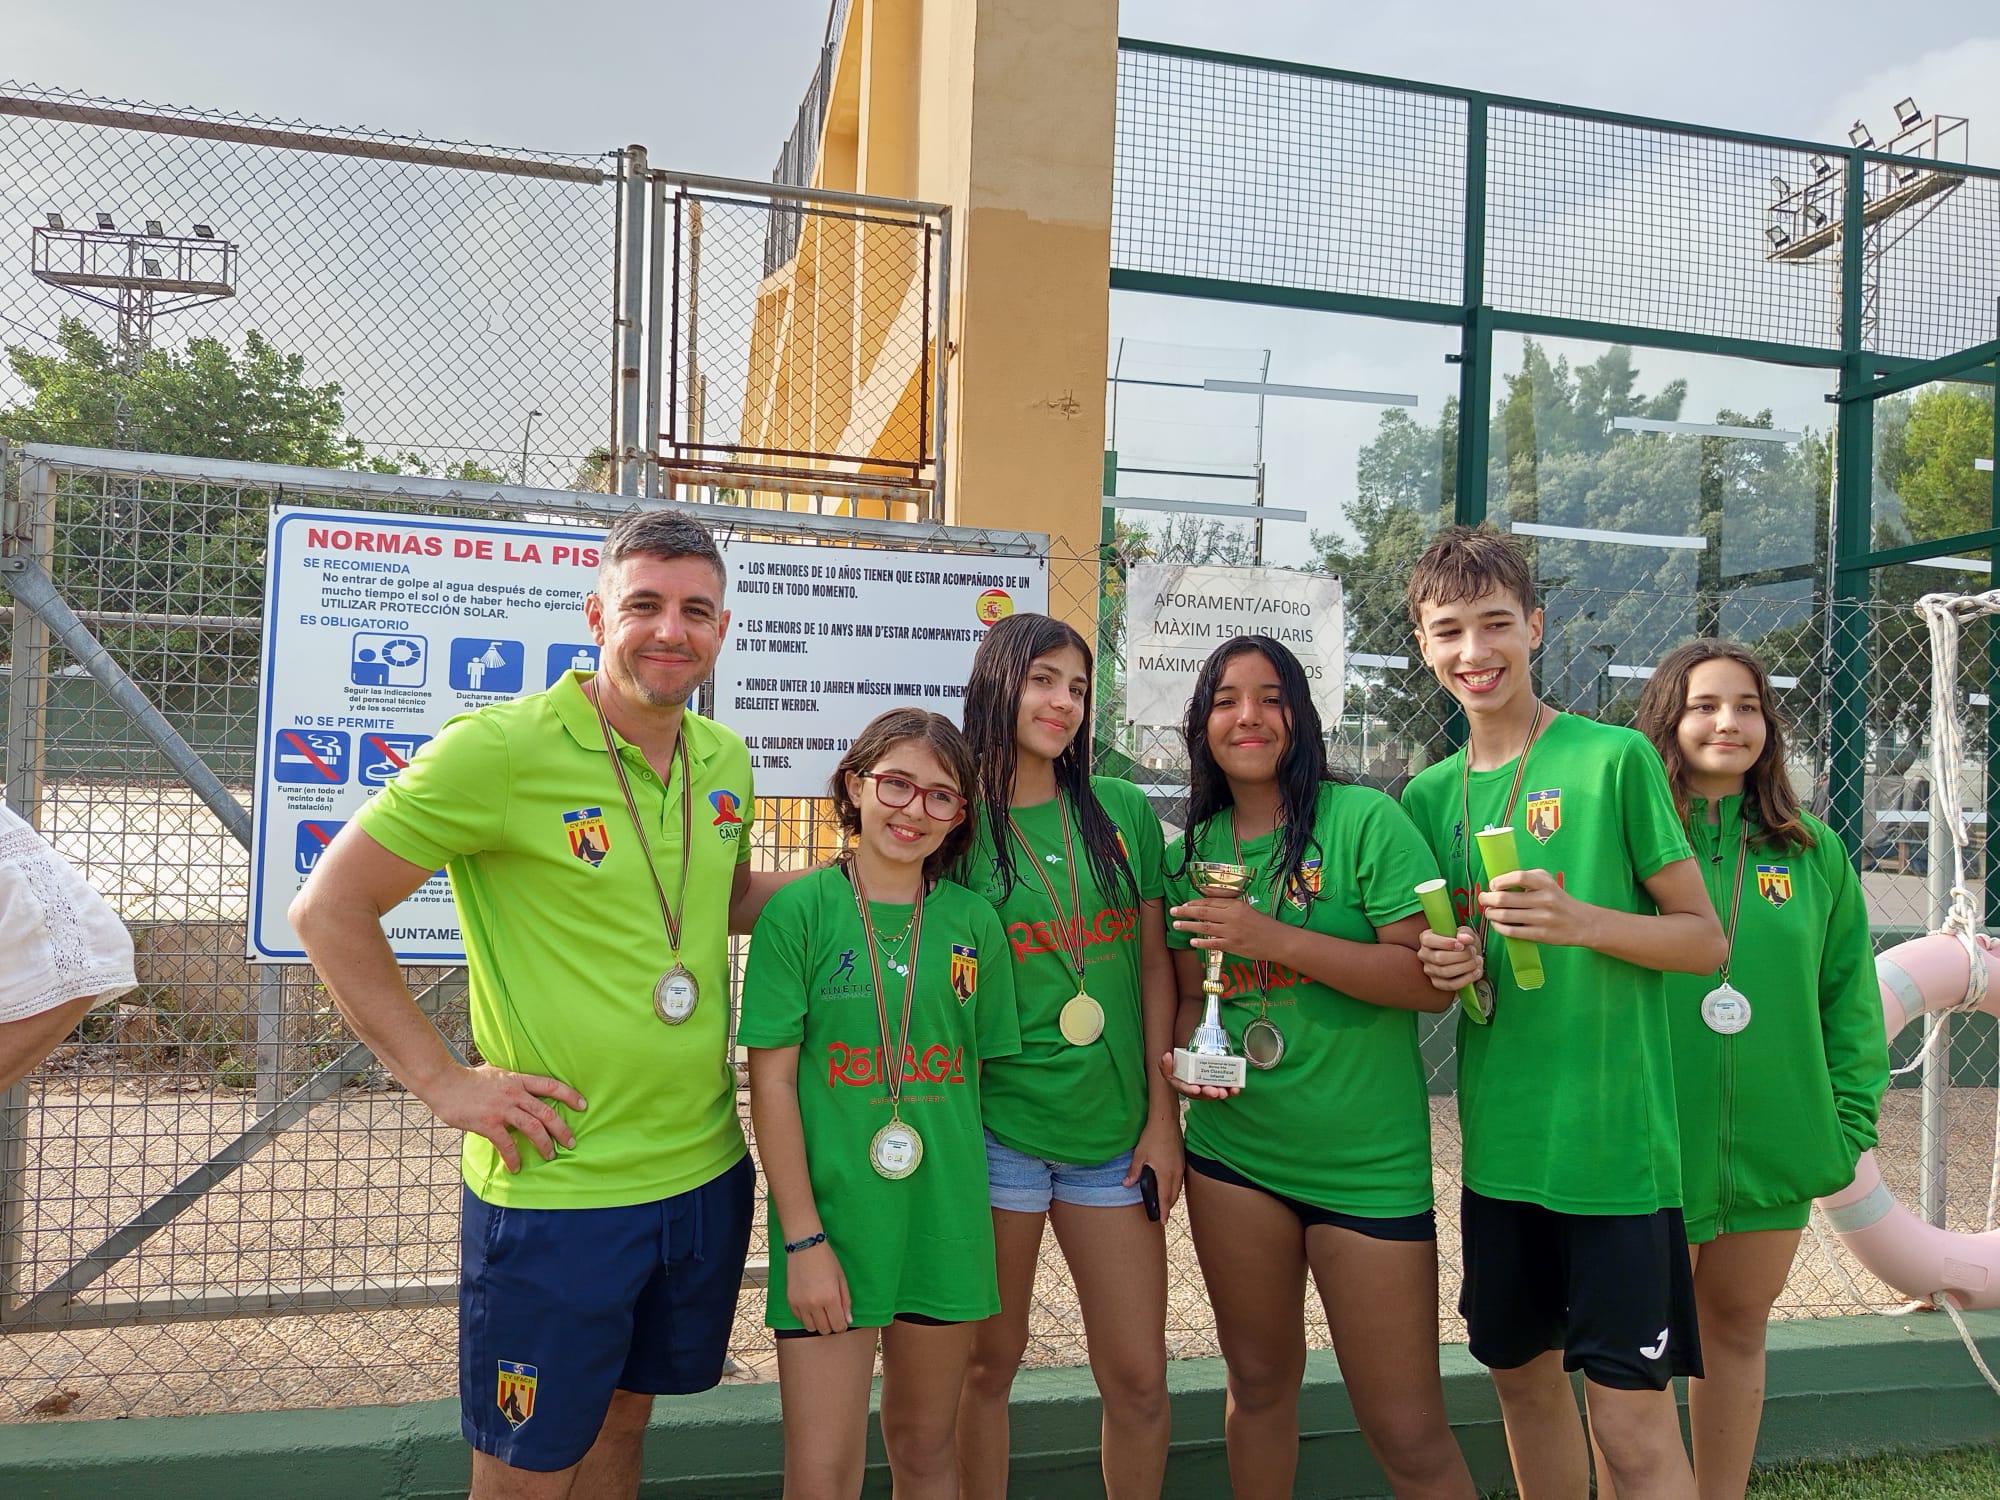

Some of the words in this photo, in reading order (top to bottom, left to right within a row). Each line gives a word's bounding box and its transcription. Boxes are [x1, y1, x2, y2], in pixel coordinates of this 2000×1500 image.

[307, 528, 443, 557] NORMAS
[453, 539, 493, 560] DE
[503, 542, 542, 564] LA
[303, 557, 319, 569] SE
[323, 559, 411, 574] RECOMIENDA
[748, 561, 765, 575] LOS
[767, 563, 809, 578] MENORES
[811, 565, 823, 578] DE
[825, 566, 836, 579] 10
[838, 565, 861, 580] AÑOS
[863, 568, 893, 582] TIENEN
[896, 570, 913, 584] QUE
[915, 571, 940, 585] ESTAR
[943, 572, 1004, 588] ACOMPAÑADOS
[1006, 576, 1017, 588] DE
[1019, 576, 1030, 589] UN
[322, 572, 339, 583] No
[342, 575, 377, 586] entrar
[380, 575, 395, 587] de
[397, 577, 430, 590] golpe
[433, 579, 443, 590] al
[446, 582, 474, 593] agua
[477, 582, 526, 597] después
[529, 585, 543, 596] de
[545, 588, 583, 600] comer,
[737, 580, 770, 594] ADULTO
[772, 582, 783, 595] EN
[786, 583, 810, 596] TODO
[812, 584, 858, 599] MOMENTO.
[321, 586, 362, 599] mucho
[365, 588, 405, 602] tiempo
[408, 589, 419, 600] el
[422, 590, 440, 602] sol
[442, 593, 450, 602] o
[452, 592, 467, 603] de
[470, 593, 502, 606] haber
[506, 597, 541, 608] hecho
[1154, 593, 1311, 617] AFORAMENT/AFORO
[321, 598, 376, 611] UTILIZAR
[380, 600, 460, 616] PROTECCIÓN
[463, 607, 509, 619] SOLAR.
[299, 615, 317, 625] ES
[320, 615, 409, 631] OBLIGATORIO
[747, 619, 763, 633] ELS
[765, 620, 802, 635] MENORS
[804, 622, 815, 635] DE
[818, 623, 829, 636] 10
[831, 623, 853, 637] ANYS
[856, 624, 873, 637] HAN
[875, 625, 909, 639] D'ESTAR
[912, 627, 971, 642] ACOMPANYATS
[1154, 617, 1211, 638] MÀXIM
[1216, 624, 1243, 638] 150
[1248, 626, 1313, 643] USUARIS
[736, 638, 748, 651] EN
[750, 639, 767, 652] TOT
[769, 640, 808, 654] MOMENT.
[343, 686, 369, 697] Seguir
[370, 688, 382, 696] las
[384, 688, 432, 698] indicaciones
[746, 678, 777, 692] KINDER
[780, 679, 808, 693] UNTER
[810, 680, 821, 693] 10
[823, 681, 855, 695] JAHREN
[857, 679, 891, 695] MÜSSEN
[893, 683, 921, 696] IMMER
[924, 684, 940, 697] VON
[943, 685, 968, 698] EINEM
[349, 695, 361, 703] del
[362, 696, 396, 706] personal
[398, 696, 426, 705] técnico
[456, 692, 492, 701] Ducharse
[735, 697, 779, 711] BEGLEITET
[781, 698, 820, 712] WERDEN.
[349, 705, 355, 713] y
[356, 704, 367, 712] de
[368, 704, 380, 712] los
[381, 705, 425, 714] socorristas
[295, 715, 313, 726] NO
[317, 716, 334, 727] SE
[338, 718, 395, 729] PERMITE
[745, 736, 759, 749] ALL
[761, 736, 803, 750] CHILDREN
[806, 738, 834, 751] UNDER
[837, 738, 848, 751] 10
[763, 755, 792, 769] TIMES.
[304, 786, 316, 795] (en
[288, 803, 332, 812] instalación)
